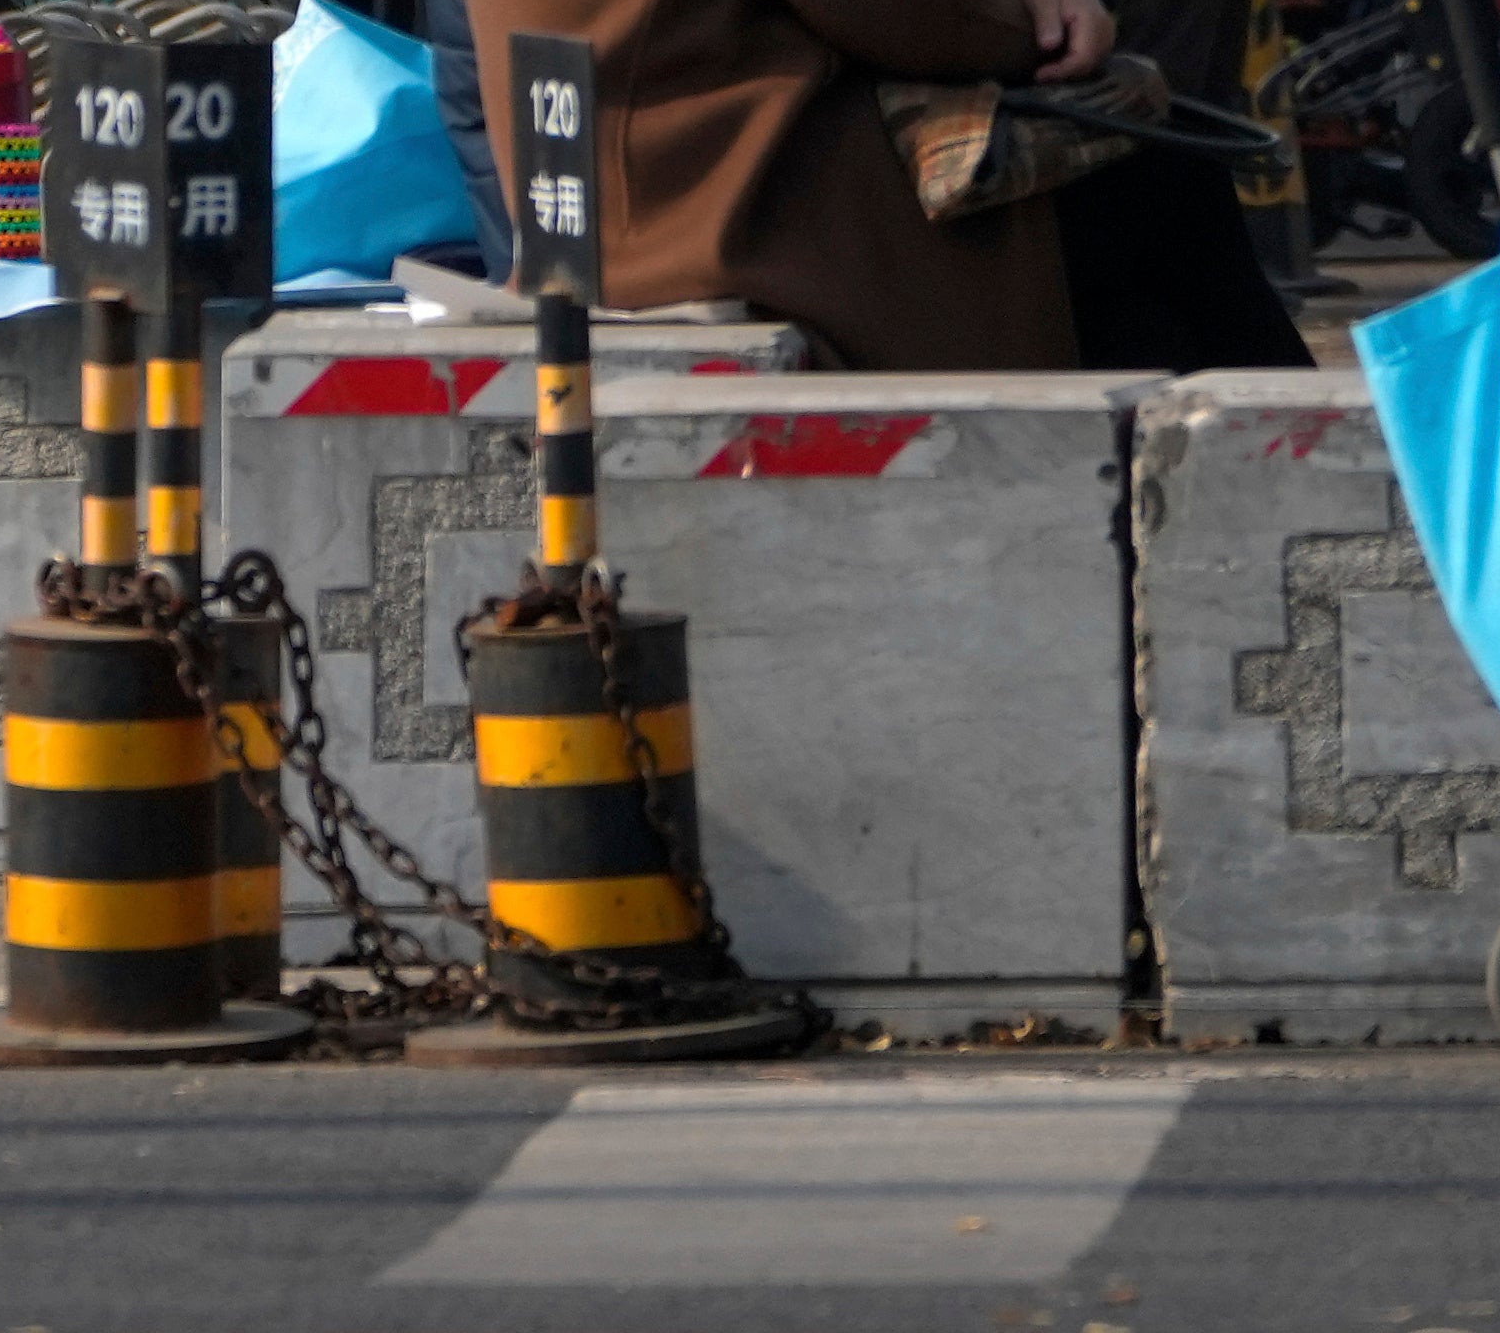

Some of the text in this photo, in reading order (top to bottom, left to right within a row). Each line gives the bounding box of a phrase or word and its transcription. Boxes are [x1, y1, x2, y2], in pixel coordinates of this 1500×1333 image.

[75, 85, 145, 148] 120
[165, 83, 234, 140] 20
[529, 78, 581, 139] 120
[70, 177, 148, 246] 专用
[168, 175, 238, 237] 用
[528, 170, 586, 236] 专用
